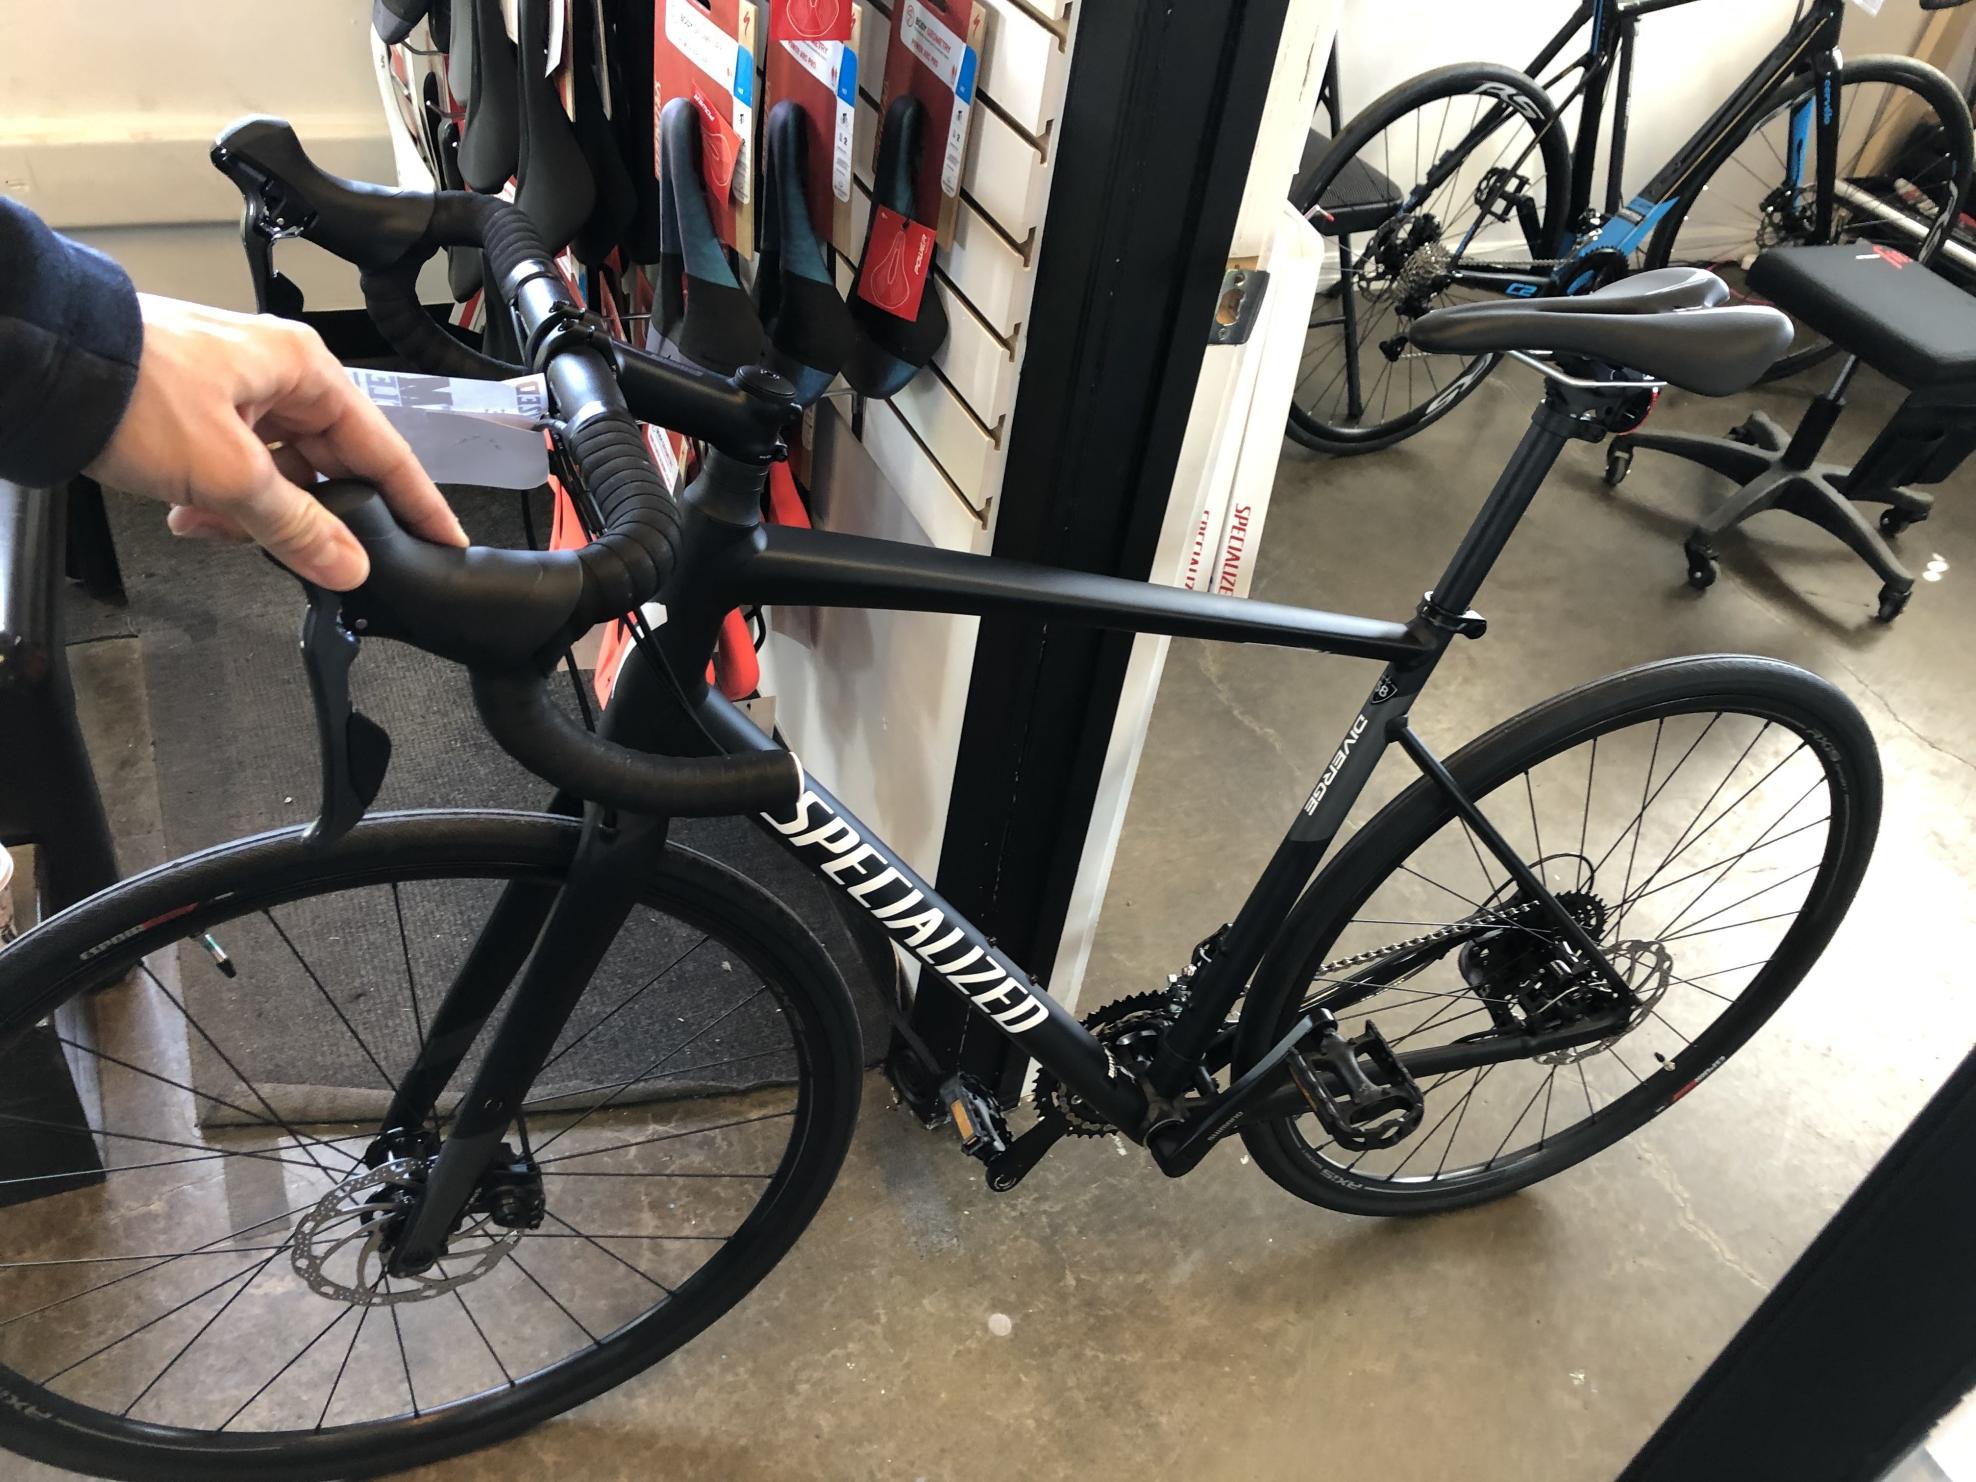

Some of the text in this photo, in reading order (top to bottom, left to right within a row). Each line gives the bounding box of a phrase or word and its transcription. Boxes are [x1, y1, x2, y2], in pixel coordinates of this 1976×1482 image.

[1219, 503, 1251, 597] SPECIALIZE
[1303, 713, 1369, 817] DIVERGE
[760, 790, 1050, 1034] SPECIALIZED
